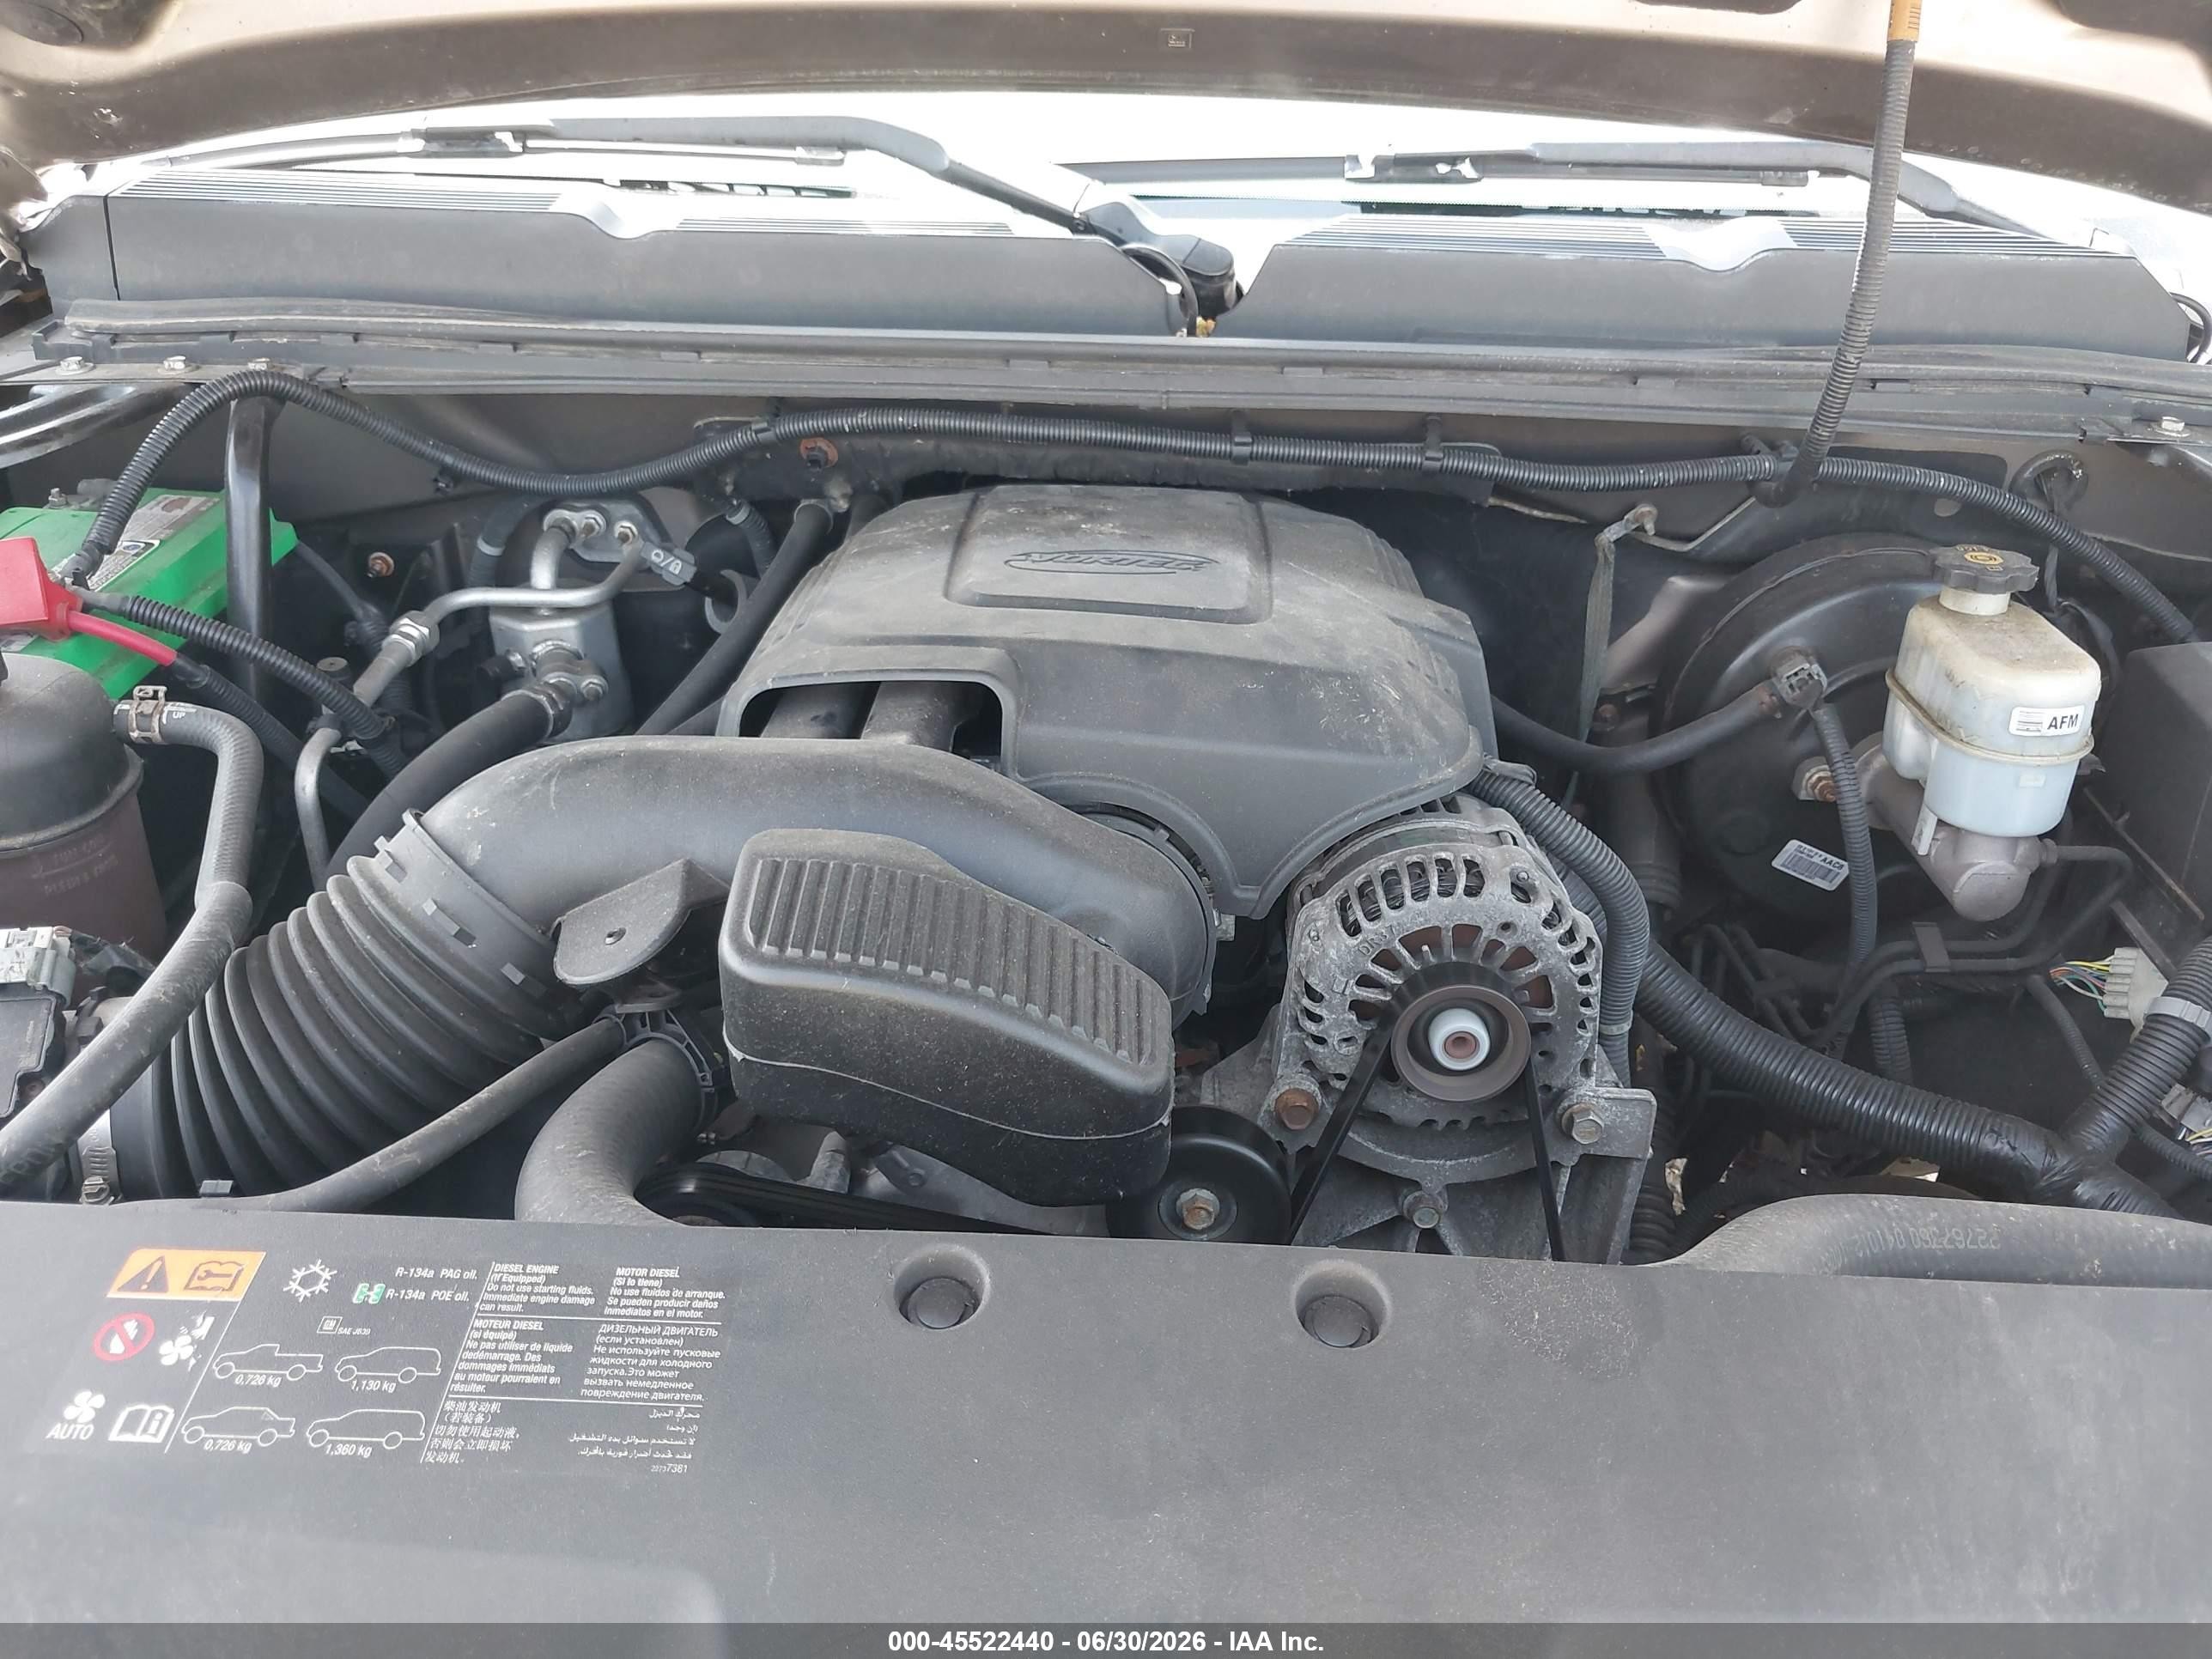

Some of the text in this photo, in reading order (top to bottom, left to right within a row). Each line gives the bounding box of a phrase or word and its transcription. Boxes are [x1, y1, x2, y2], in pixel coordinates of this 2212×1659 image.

[2047, 714, 2079, 730] AFM
[395, 1267, 434, 1278] R-134a
[440, 1268, 462, 1279] PAG
[494, 1263, 559, 1274] DIESEL ENGINE
[616, 1267, 680, 1278] MOTOR DIESEL
[487, 1283, 499, 1291] Do
[500, 1284, 514, 1292] not
[533, 1285, 567, 1295] starting
[568, 1285, 593, 1295] fluids.
[637, 1279, 663, 1288] tiene)
[386, 1289, 426, 1300] R-134a
[431, 1291, 453, 1301] POE
[610, 1287, 623, 1296] No
[641, 1288, 671, 1297] fluidos
[672, 1289, 684, 1297] de
[684, 1291, 726, 1299] arranque.
[530, 1296, 559, 1304] engine
[561, 1295, 595, 1306] damage
[607, 1297, 720, 1309] Se pueden producir daños
[497, 1304, 524, 1312] result.
[665, 1309, 676, 1318] el
[677, 1310, 704, 1318] motor.
[473, 1319, 544, 1331] MOTEUR DIESEL
[599, 1323, 719, 1337] ДИЗЕЛЬНЫЙ ДВИГАТЕЛЬ
[596, 1334, 684, 1347] (если установлен)
[465, 1340, 573, 1354] Ne pas utiliser de liquide
[593, 1345, 721, 1358] Не используйте пусковые
[524, 1352, 542, 1362] Des
[590, 1357, 713, 1369] жидкости для холодного
[458, 1361, 507, 1373] dommages
[549, 1376, 561, 1384] en
[647, 1370, 680, 1378] может
[266, 1375, 282, 1388] kg
[382, 1381, 397, 1394] kg
[584, 1378, 694, 1389] вызвать немедленное
[580, 1389, 705, 1401] повреждение двигателя.
[46, 1423, 94, 1440] AUTO
[237, 1440, 252, 1453] kg
[357, 1444, 373, 1458] kg
